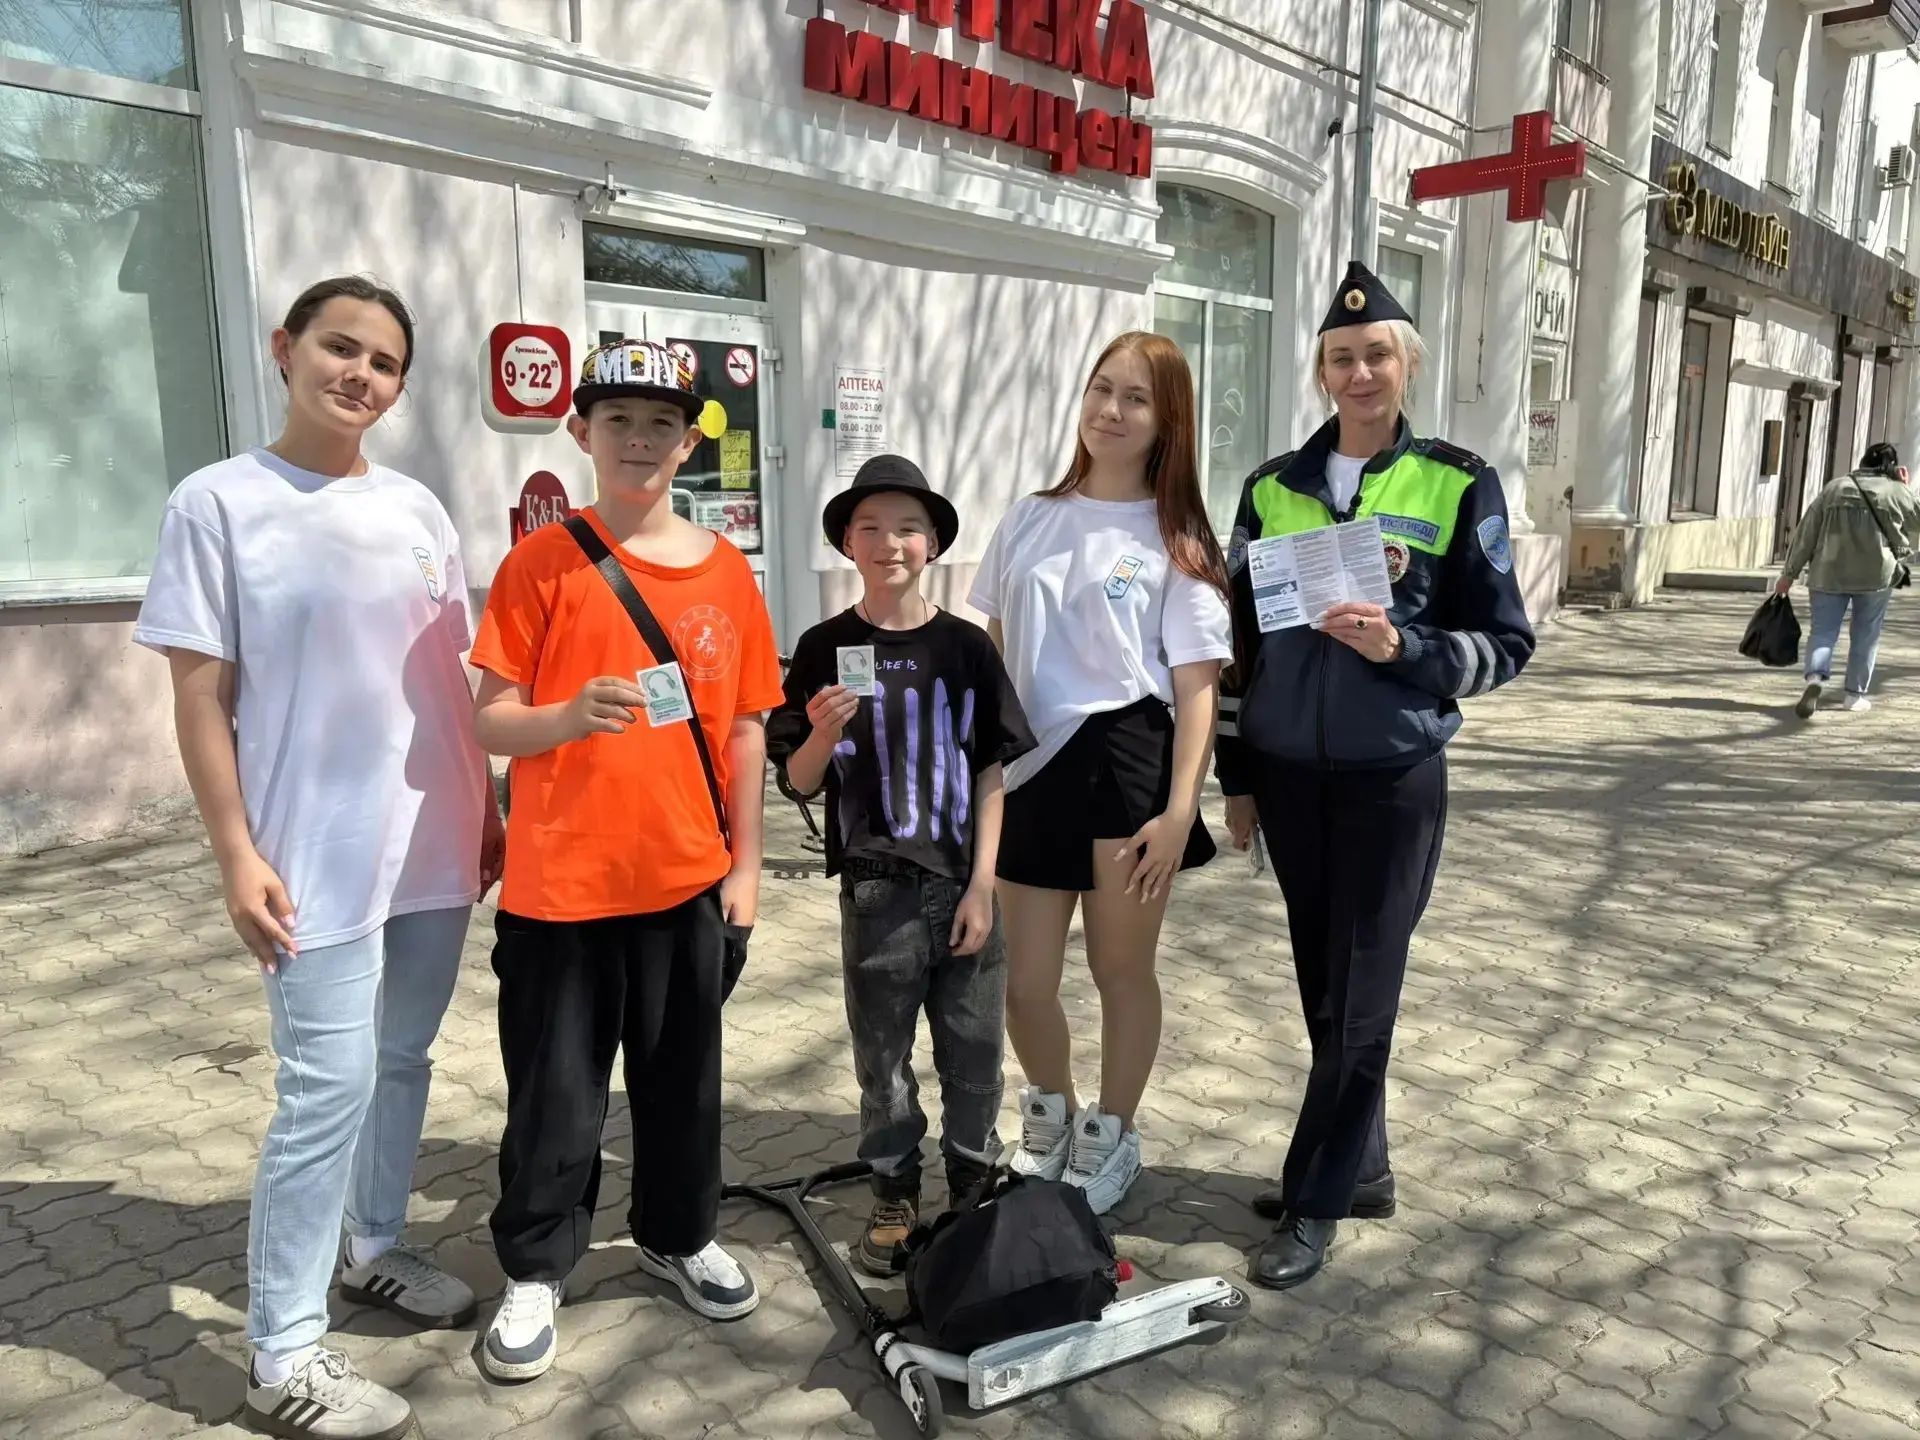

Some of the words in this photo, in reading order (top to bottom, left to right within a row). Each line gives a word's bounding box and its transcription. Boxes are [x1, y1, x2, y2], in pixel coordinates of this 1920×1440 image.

[855, 0, 1154, 98] ЕКА
[1745, 211, 1791, 270] ЛАЙН
[838, 376, 884, 392] АПТЕКА
[875, 659, 903, 671] LIFE
[907, 659, 918, 670] IS
